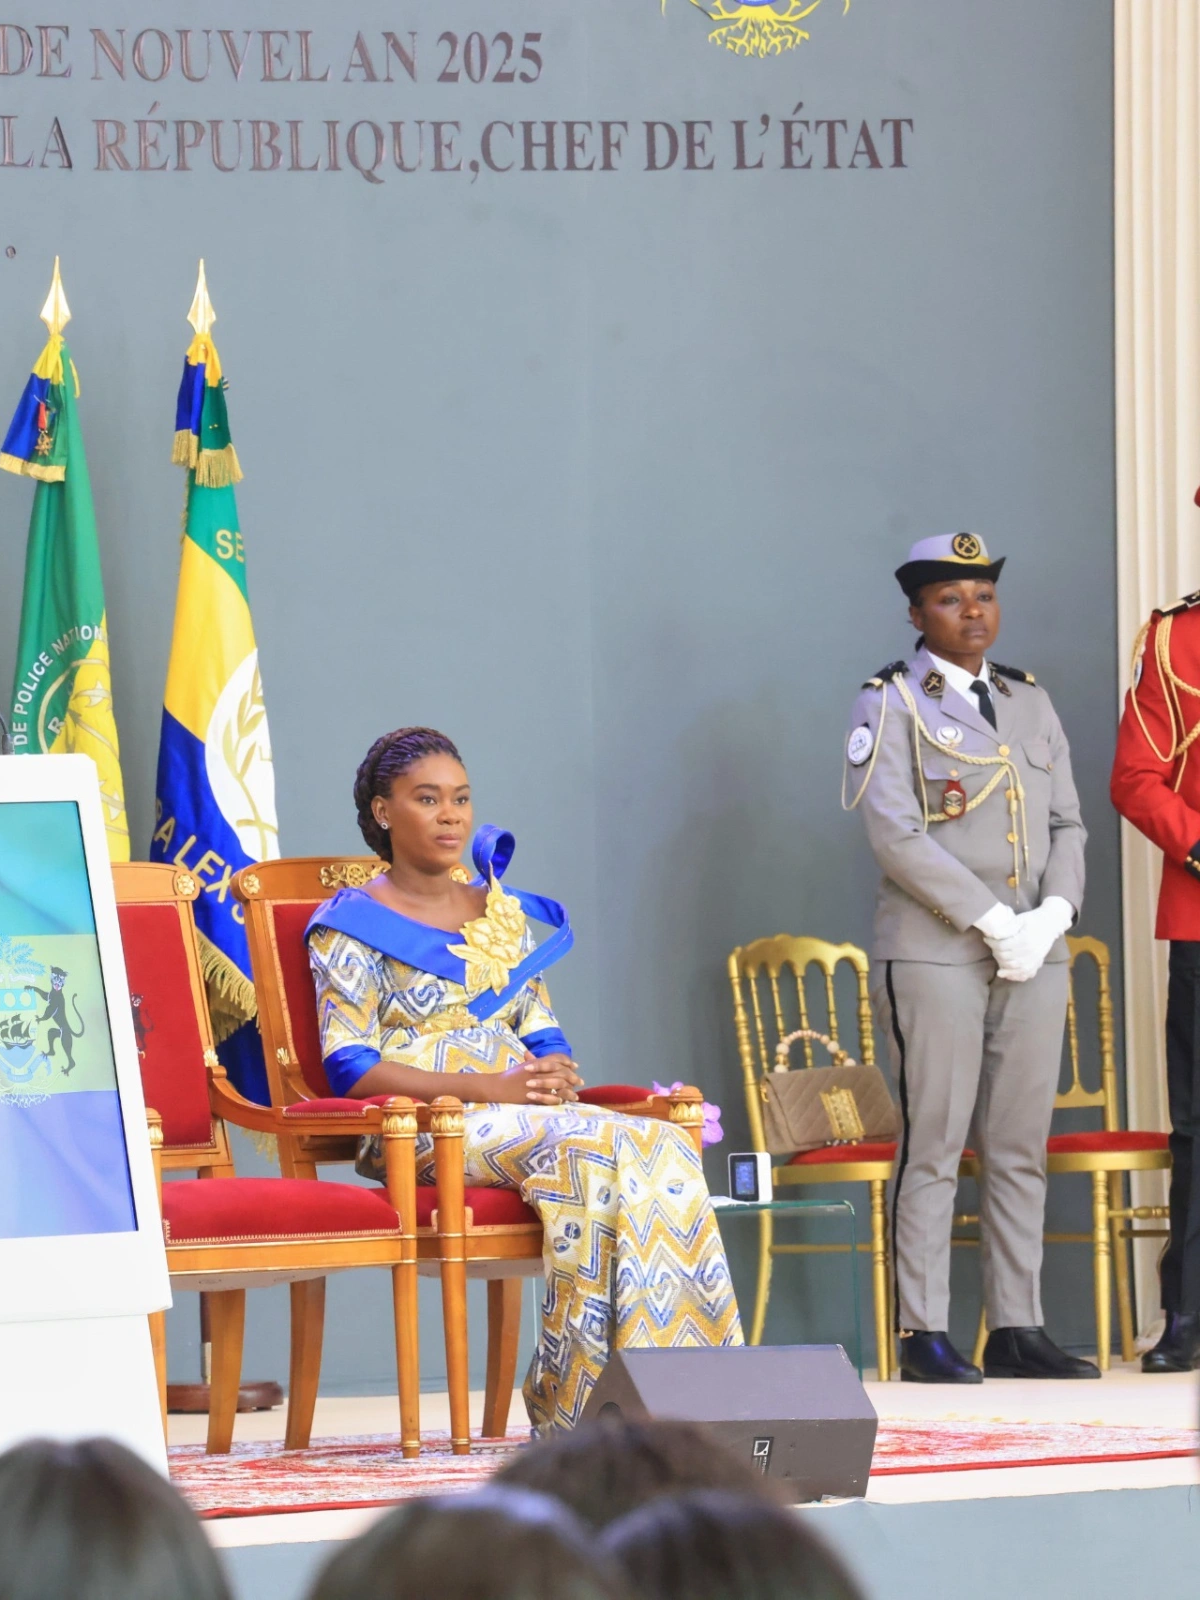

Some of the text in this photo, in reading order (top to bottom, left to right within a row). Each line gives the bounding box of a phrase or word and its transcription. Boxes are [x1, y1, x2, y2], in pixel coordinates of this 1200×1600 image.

[90, 28, 332, 83] NOUVEL
[342, 31, 420, 83] AN
[436, 32, 545, 84] 2025
[0, 114, 74, 171] LA
[642, 121, 717, 171] DE
[12, 623, 109, 747] DE POLICE NATION
